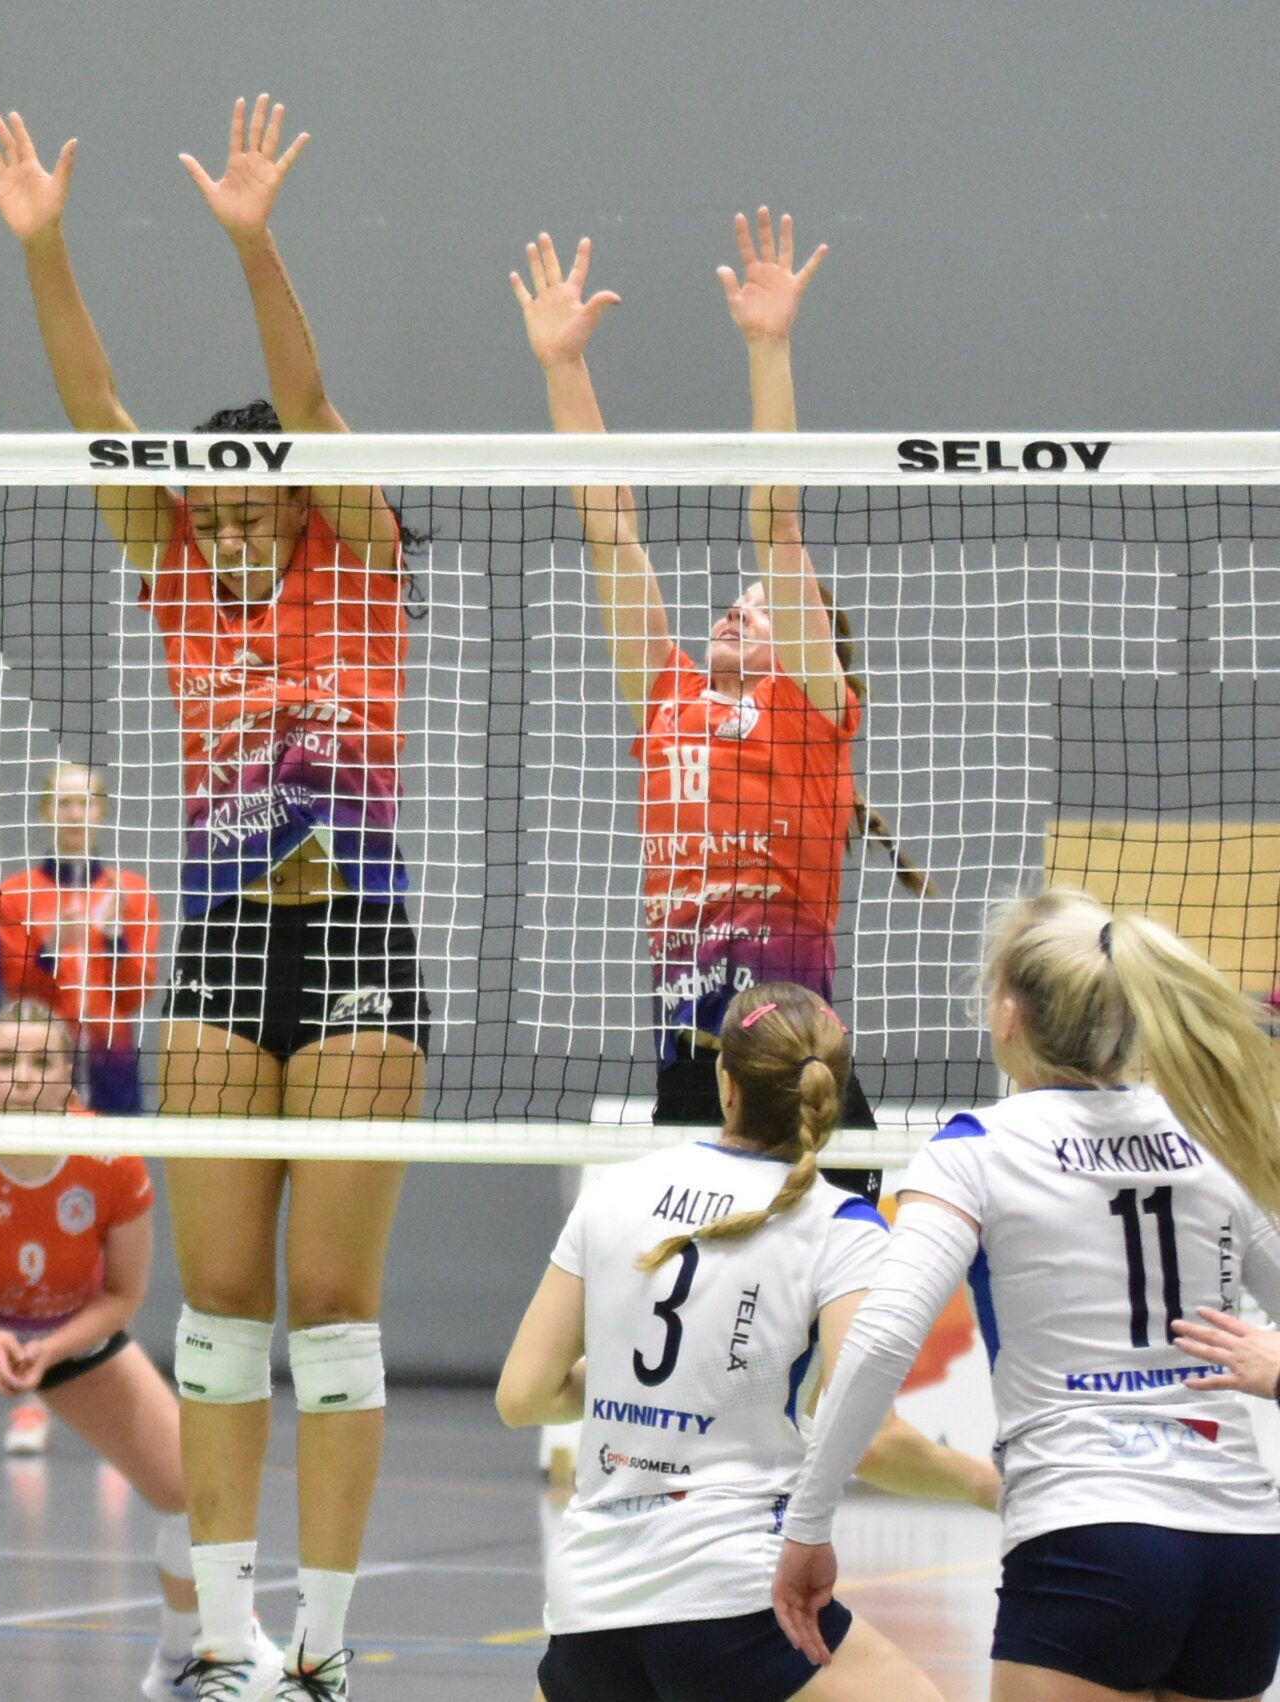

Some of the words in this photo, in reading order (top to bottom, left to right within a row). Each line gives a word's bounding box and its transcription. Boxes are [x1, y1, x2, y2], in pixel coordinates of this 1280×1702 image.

[89, 439, 293, 472] SELOY
[897, 439, 1112, 473] SELOY
[662, 745, 709, 802] 18
[699, 829, 772, 856] AMK
[1051, 1131, 1204, 1173] KUKKONEN
[652, 1184, 735, 1226] AALTO
[19, 1242, 46, 1287] 9
[1108, 1185, 1184, 1348] 11
[633, 1240, 699, 1387] 3
[727, 1283, 760, 1372] TELILÄ
[593, 1398, 716, 1435] KIVINIITTY
